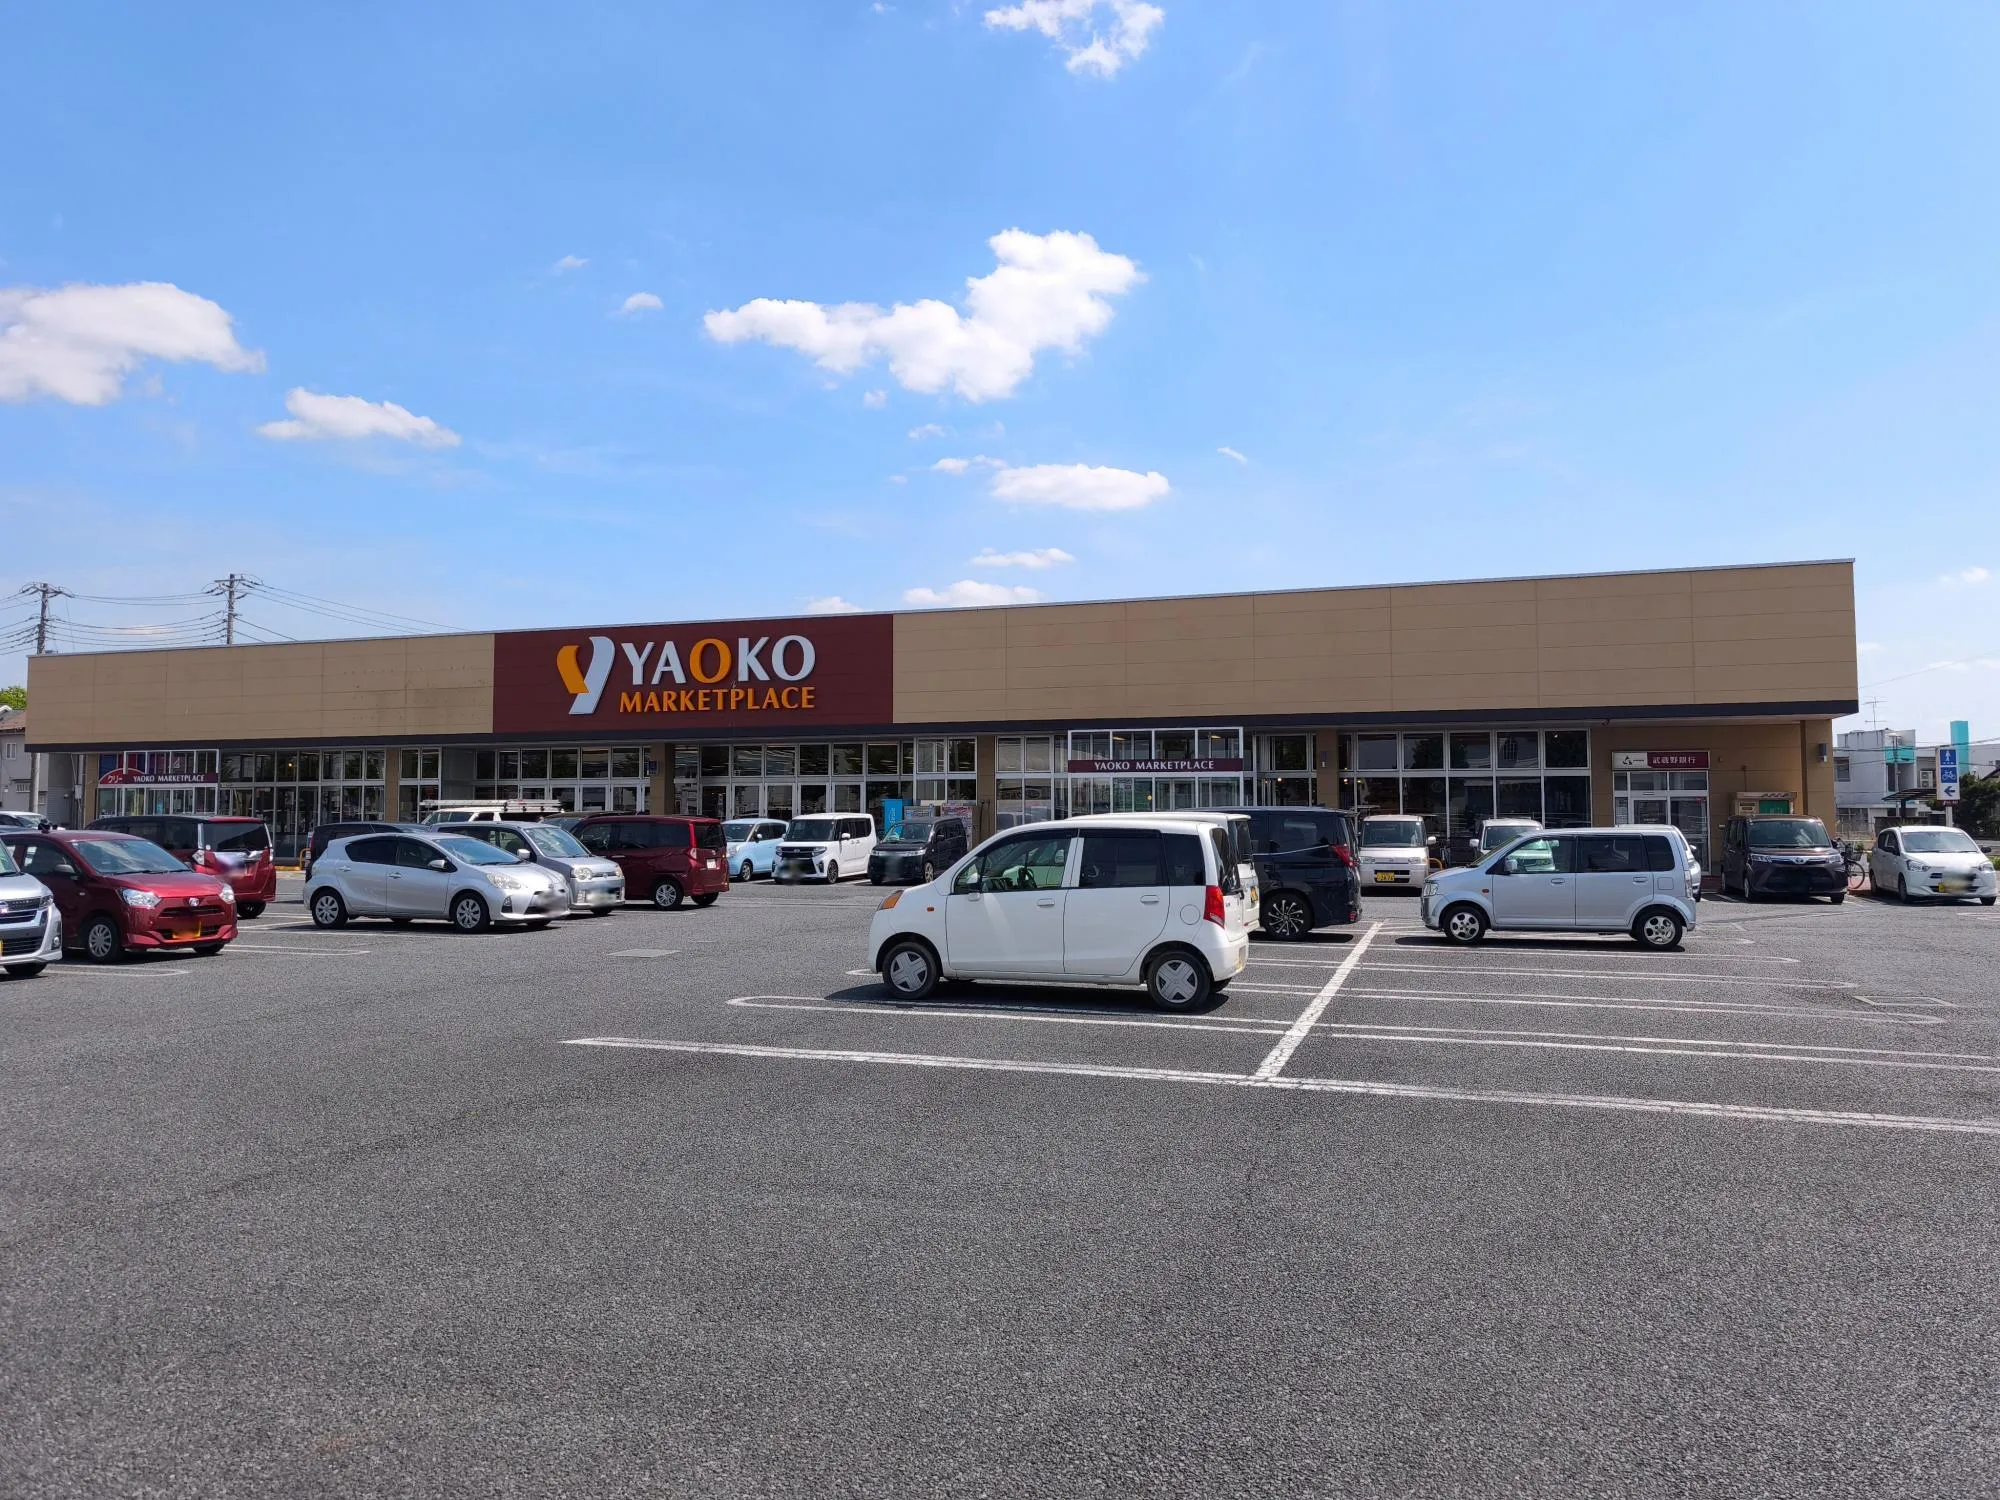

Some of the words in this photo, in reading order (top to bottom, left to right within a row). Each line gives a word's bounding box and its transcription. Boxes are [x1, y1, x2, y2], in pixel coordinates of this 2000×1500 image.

[621, 635, 816, 686] YAOKO
[619, 686, 816, 714] MARKETPLACE
[1094, 761, 1130, 771] YAOKO
[1136, 760, 1215, 770] MARKETPLACE
[133, 774, 155, 783] YAOKO
[157, 774, 205, 783] MARKETPLACE
